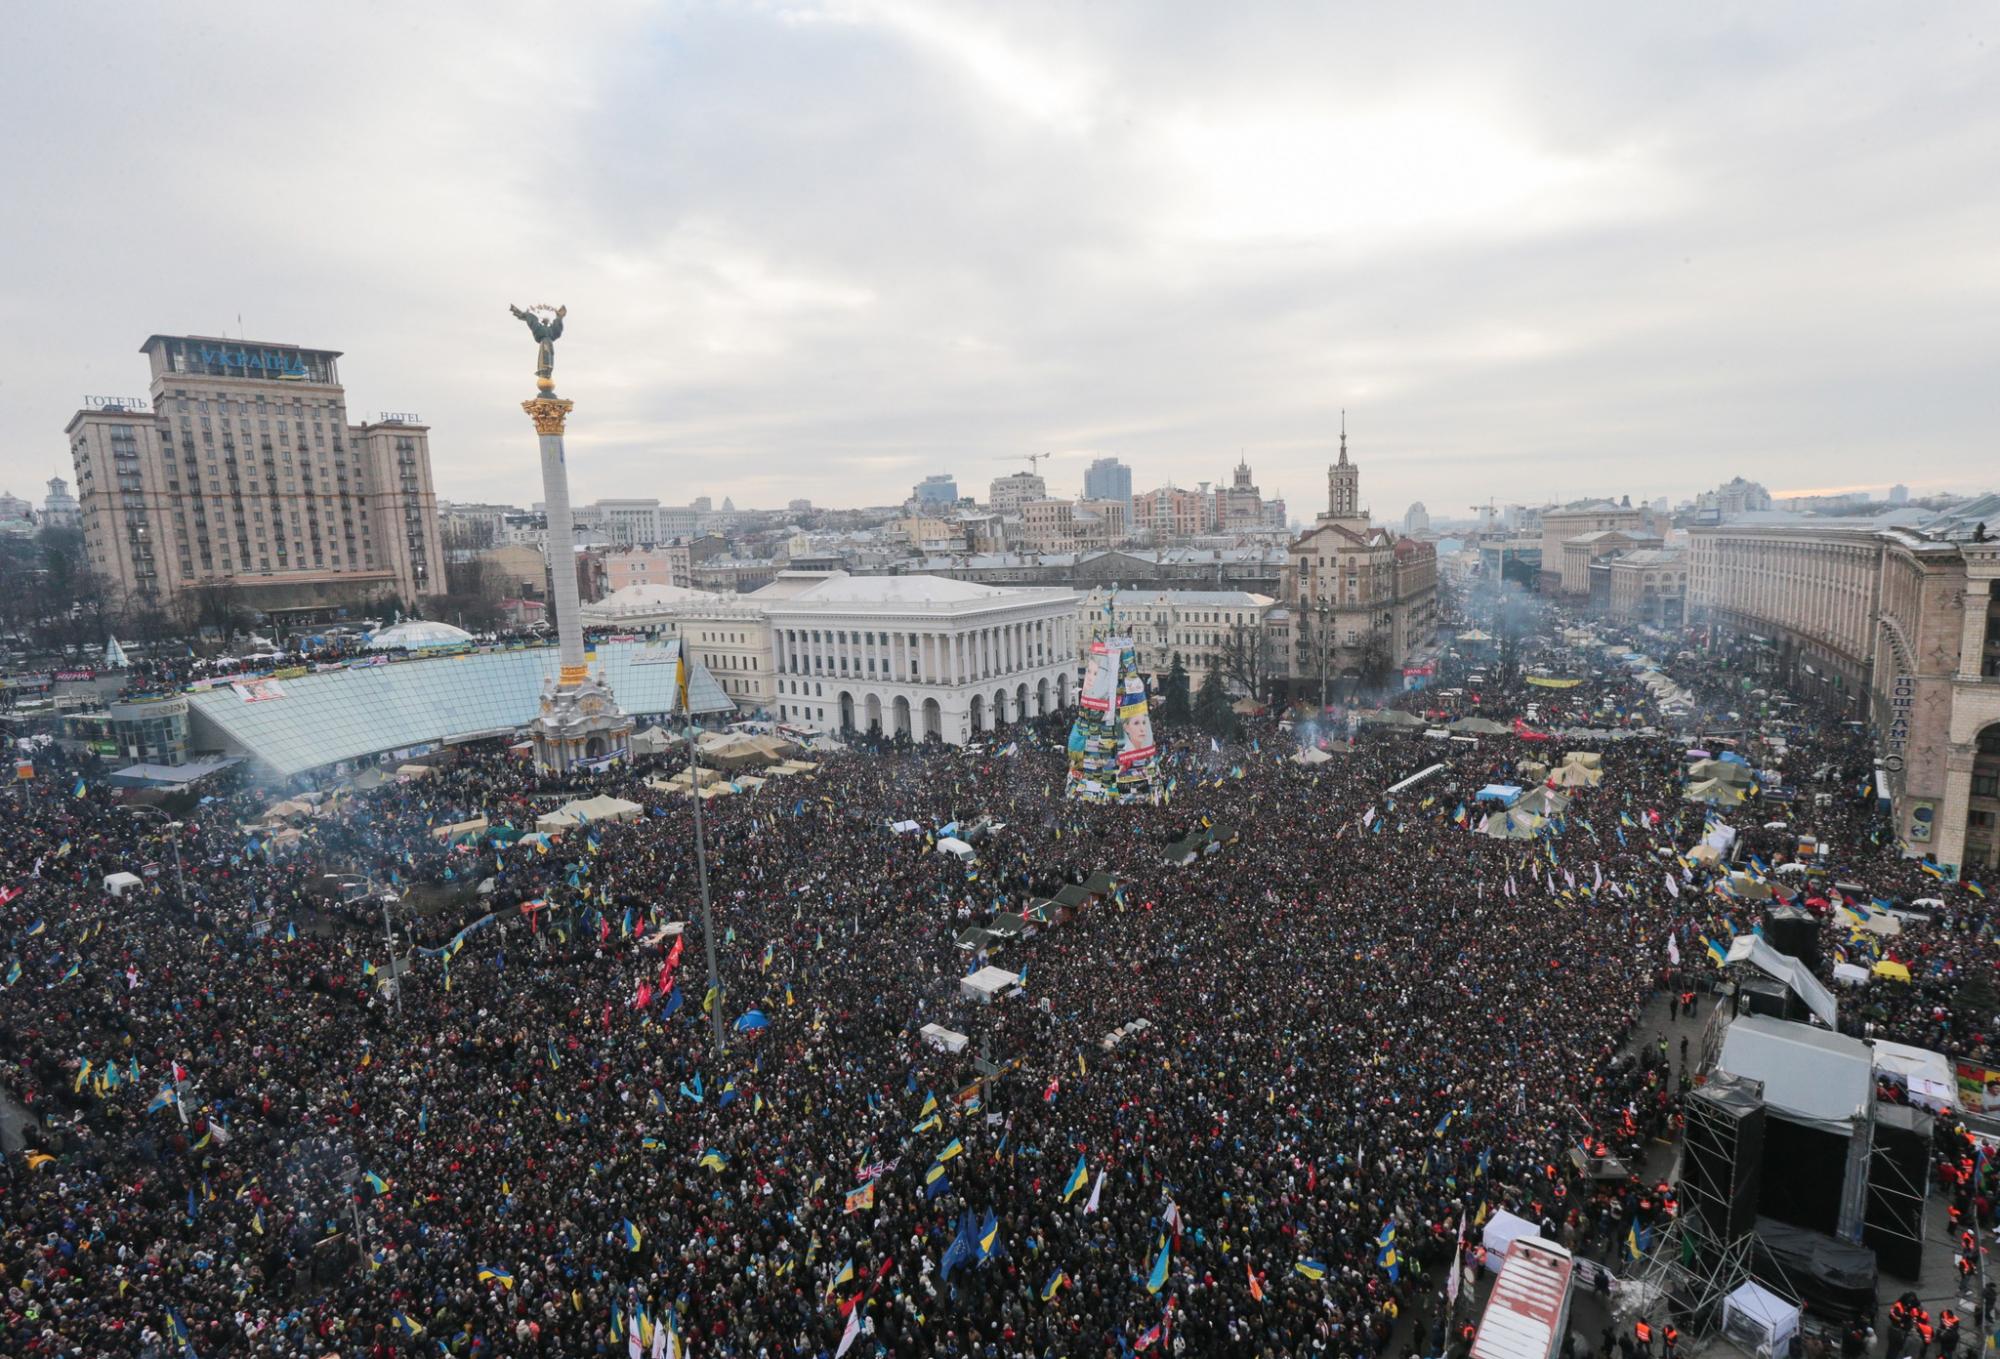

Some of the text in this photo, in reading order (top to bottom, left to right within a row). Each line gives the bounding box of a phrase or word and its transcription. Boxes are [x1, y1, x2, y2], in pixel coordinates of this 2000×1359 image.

[200, 350, 304, 370] УКРАЇНА
[84, 395, 148, 408] ГОТЕЛЬ
[380, 411, 422, 422] HOTEL
[1889, 677, 1912, 749] ПОШТАМТ
